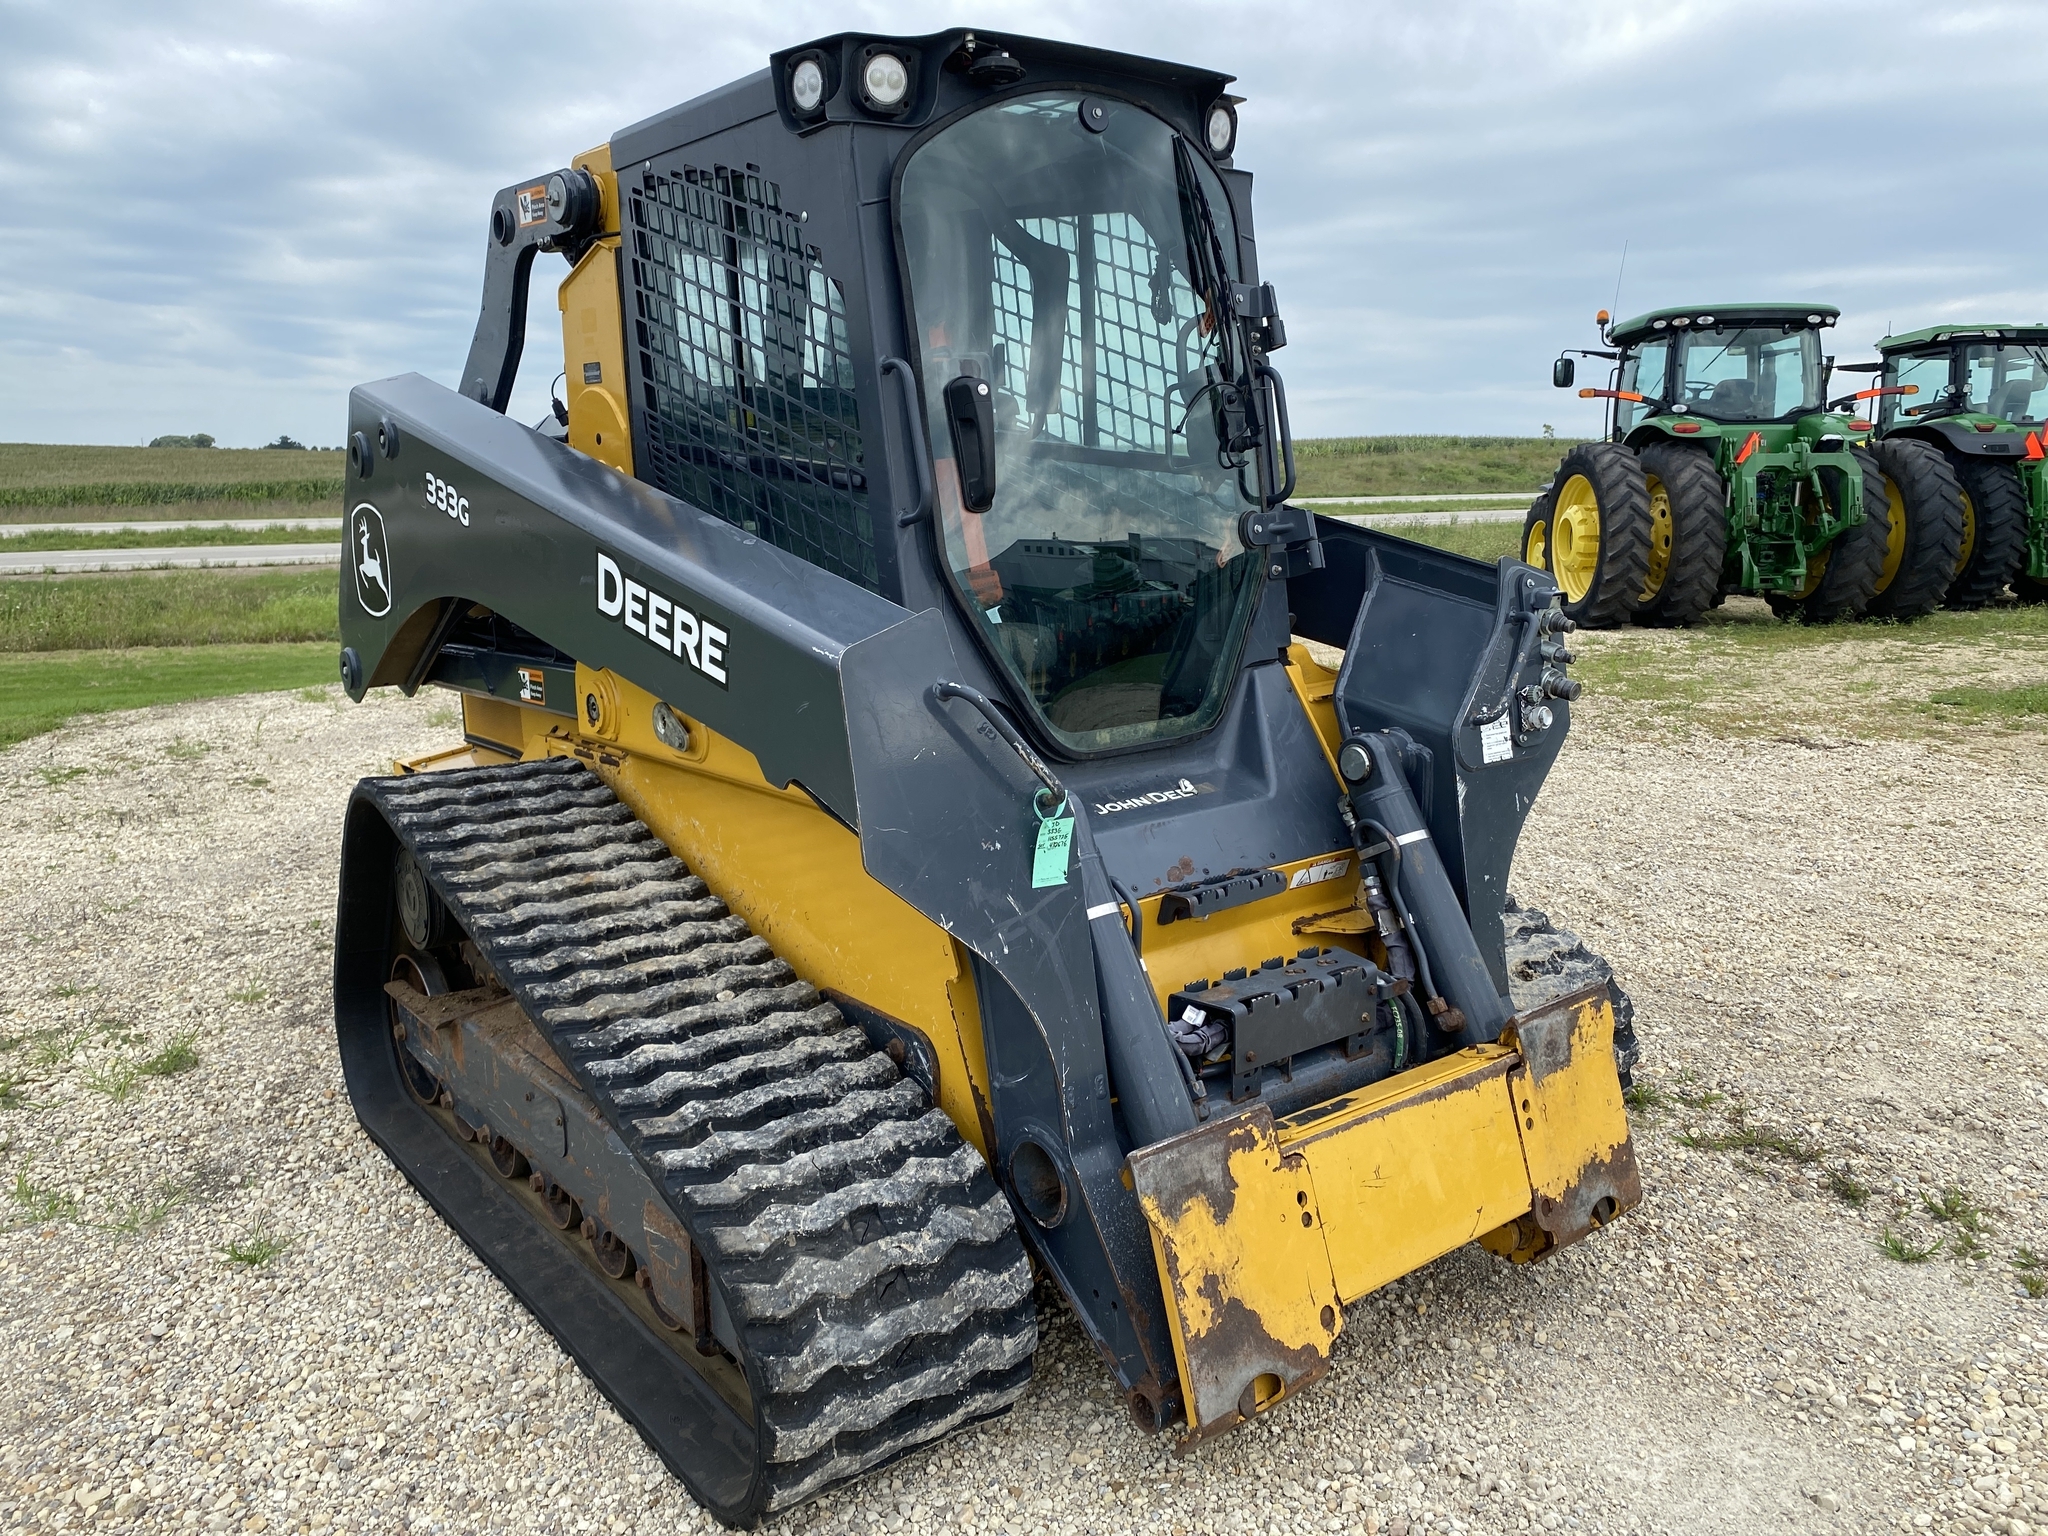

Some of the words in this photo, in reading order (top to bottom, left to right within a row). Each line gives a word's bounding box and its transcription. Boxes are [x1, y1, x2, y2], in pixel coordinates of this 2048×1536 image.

[425, 472, 470, 527] 333G
[597, 552, 728, 684] DEERE
[1095, 796, 1151, 815] JOHN
